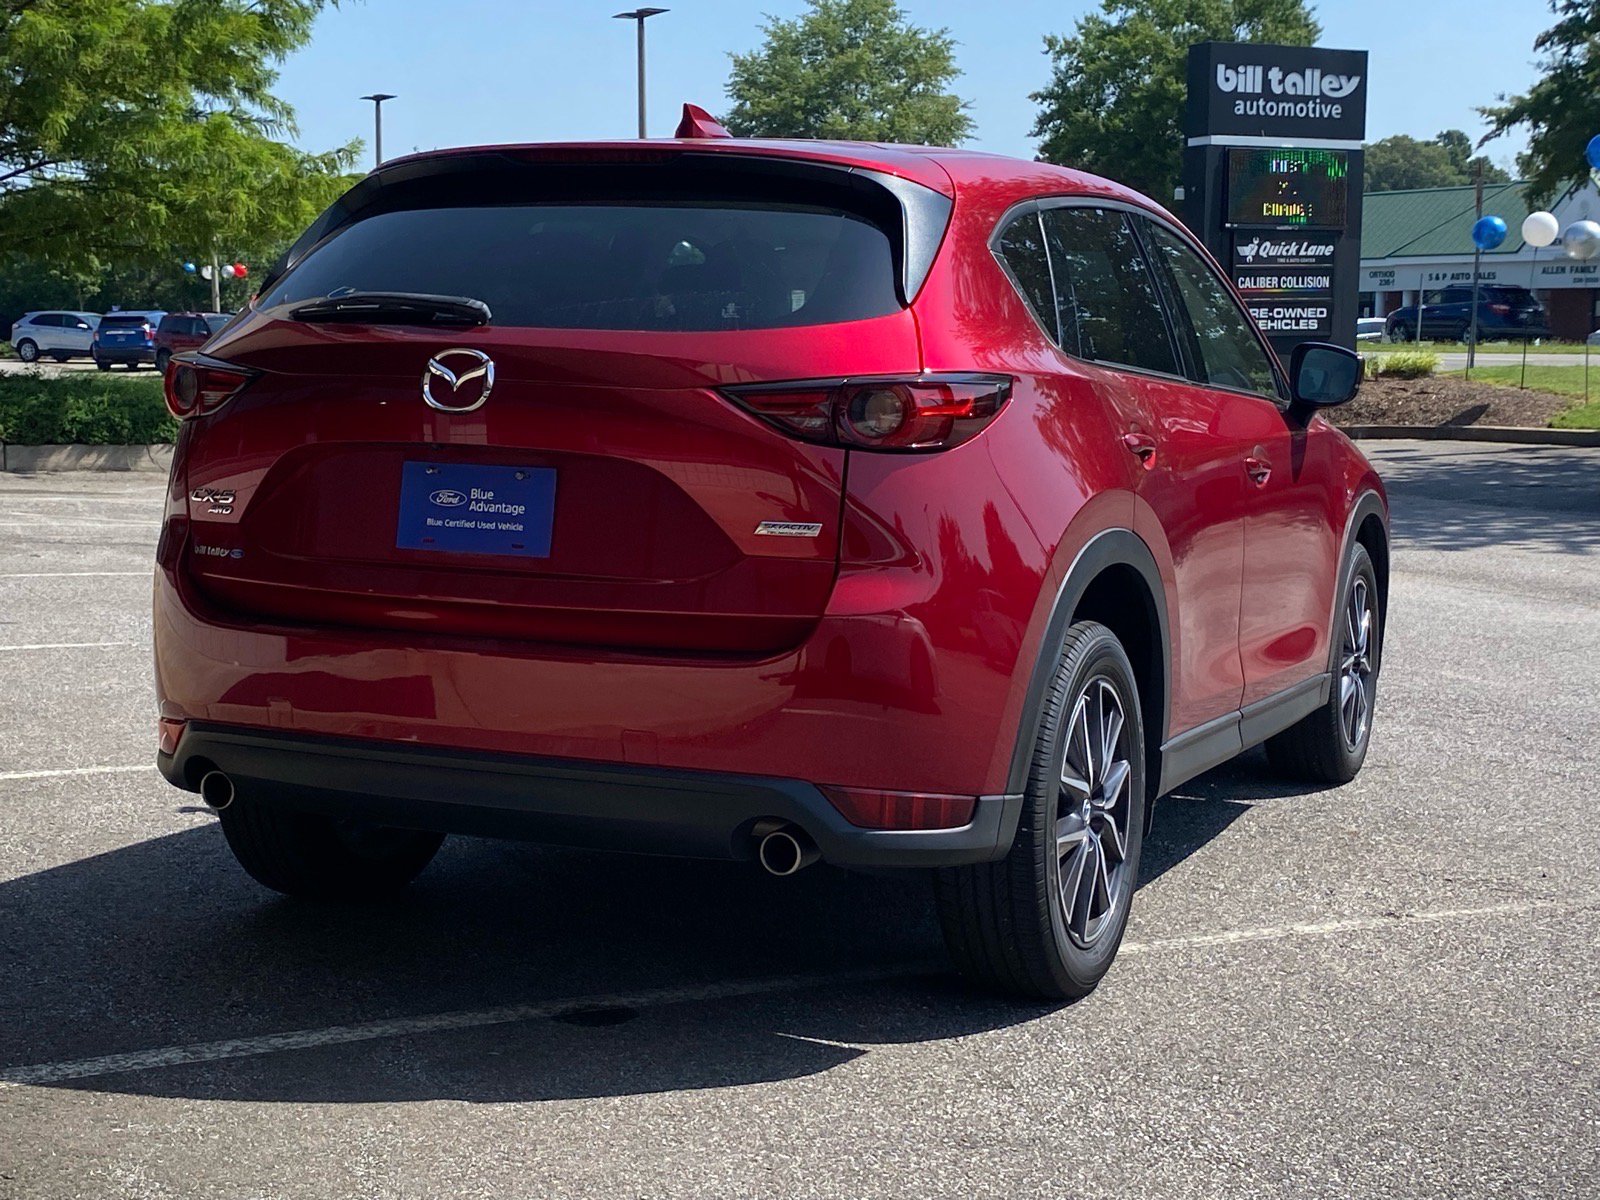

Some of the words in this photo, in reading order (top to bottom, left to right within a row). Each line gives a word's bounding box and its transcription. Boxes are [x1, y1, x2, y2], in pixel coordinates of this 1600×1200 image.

[1216, 63, 1263, 94] bill
[1268, 66, 1361, 98] talley
[1234, 98, 1342, 119] automotive
[1259, 241, 1299, 258] Quick
[1299, 242, 1334, 256] Lane
[1238, 277, 1279, 289] CALIBER
[1280, 276, 1330, 288] COLLISION
[1450, 272, 1471, 281] AUTO
[1249, 307, 1327, 319] RE-OWNED
[1256, 319, 1318, 330] EHICLES
[191, 488, 236, 504] CX-5
[436, 492, 460, 504] Ford
[470, 488, 494, 500] Blue
[468, 501, 526, 516] Advantage
[426, 518, 443, 526] Blue
[444, 520, 476, 529] Certified
[477, 521, 496, 530] Used
[497, 523, 524, 532] Vehicle
